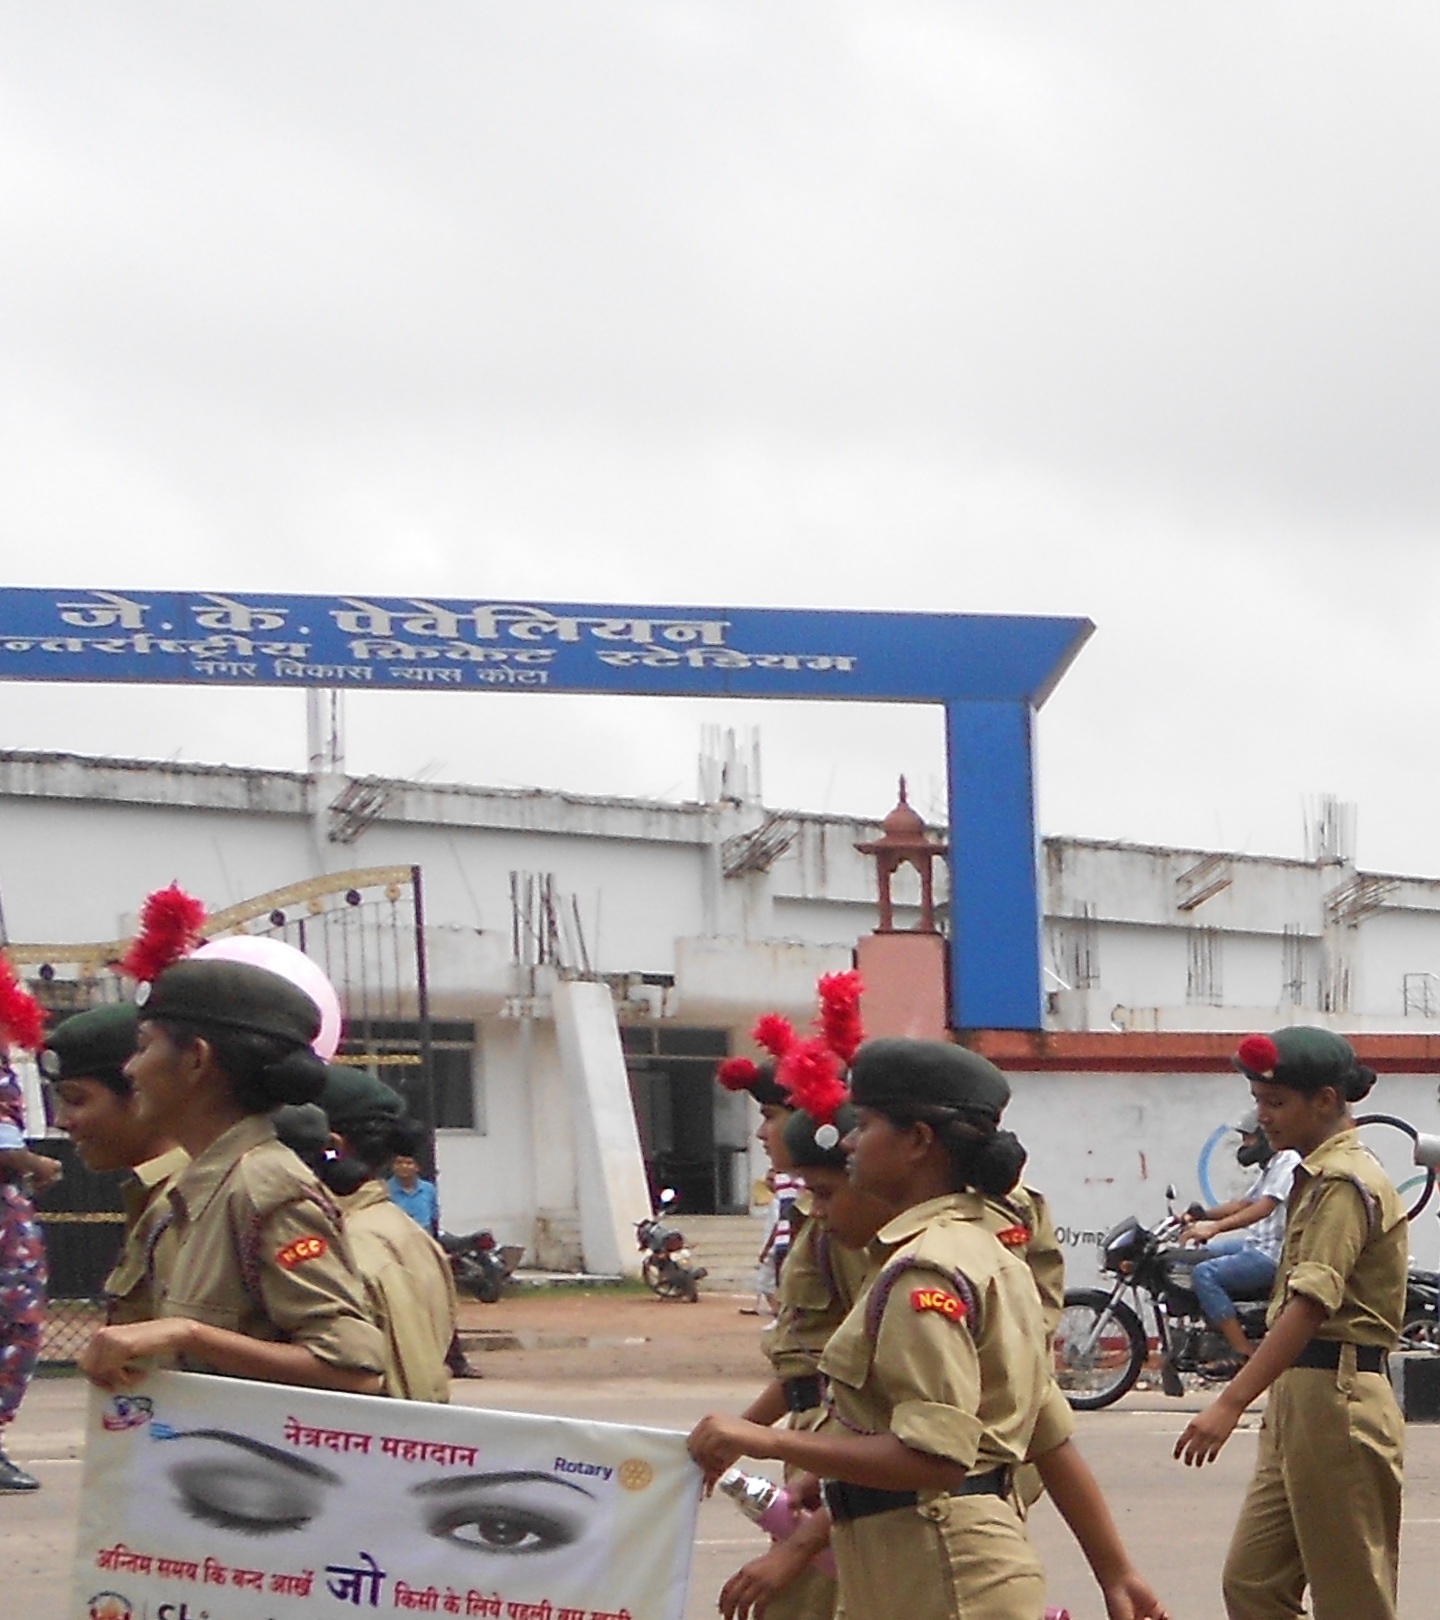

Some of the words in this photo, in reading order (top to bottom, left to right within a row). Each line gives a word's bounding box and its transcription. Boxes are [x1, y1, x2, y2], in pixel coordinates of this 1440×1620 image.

[329, 597, 732, 646] पेवेलियन
[0, 633, 312, 658] न्तर्राष्ट्रीय
[596, 645, 858, 672] स्टेडियम
[192, 660, 257, 677] नगर
[274, 658, 373, 681] विकास
[478, 664, 548, 685] कोटा
[1055, 1226, 1107, 1247] Olymp
[919, 1293, 957, 1312] NCC
[284, 1416, 373, 1455] नेत्रदान
[380, 1436, 479, 1467] महादान
[554, 1457, 613, 1481] Rotary
[325, 1551, 386, 1607] जो
